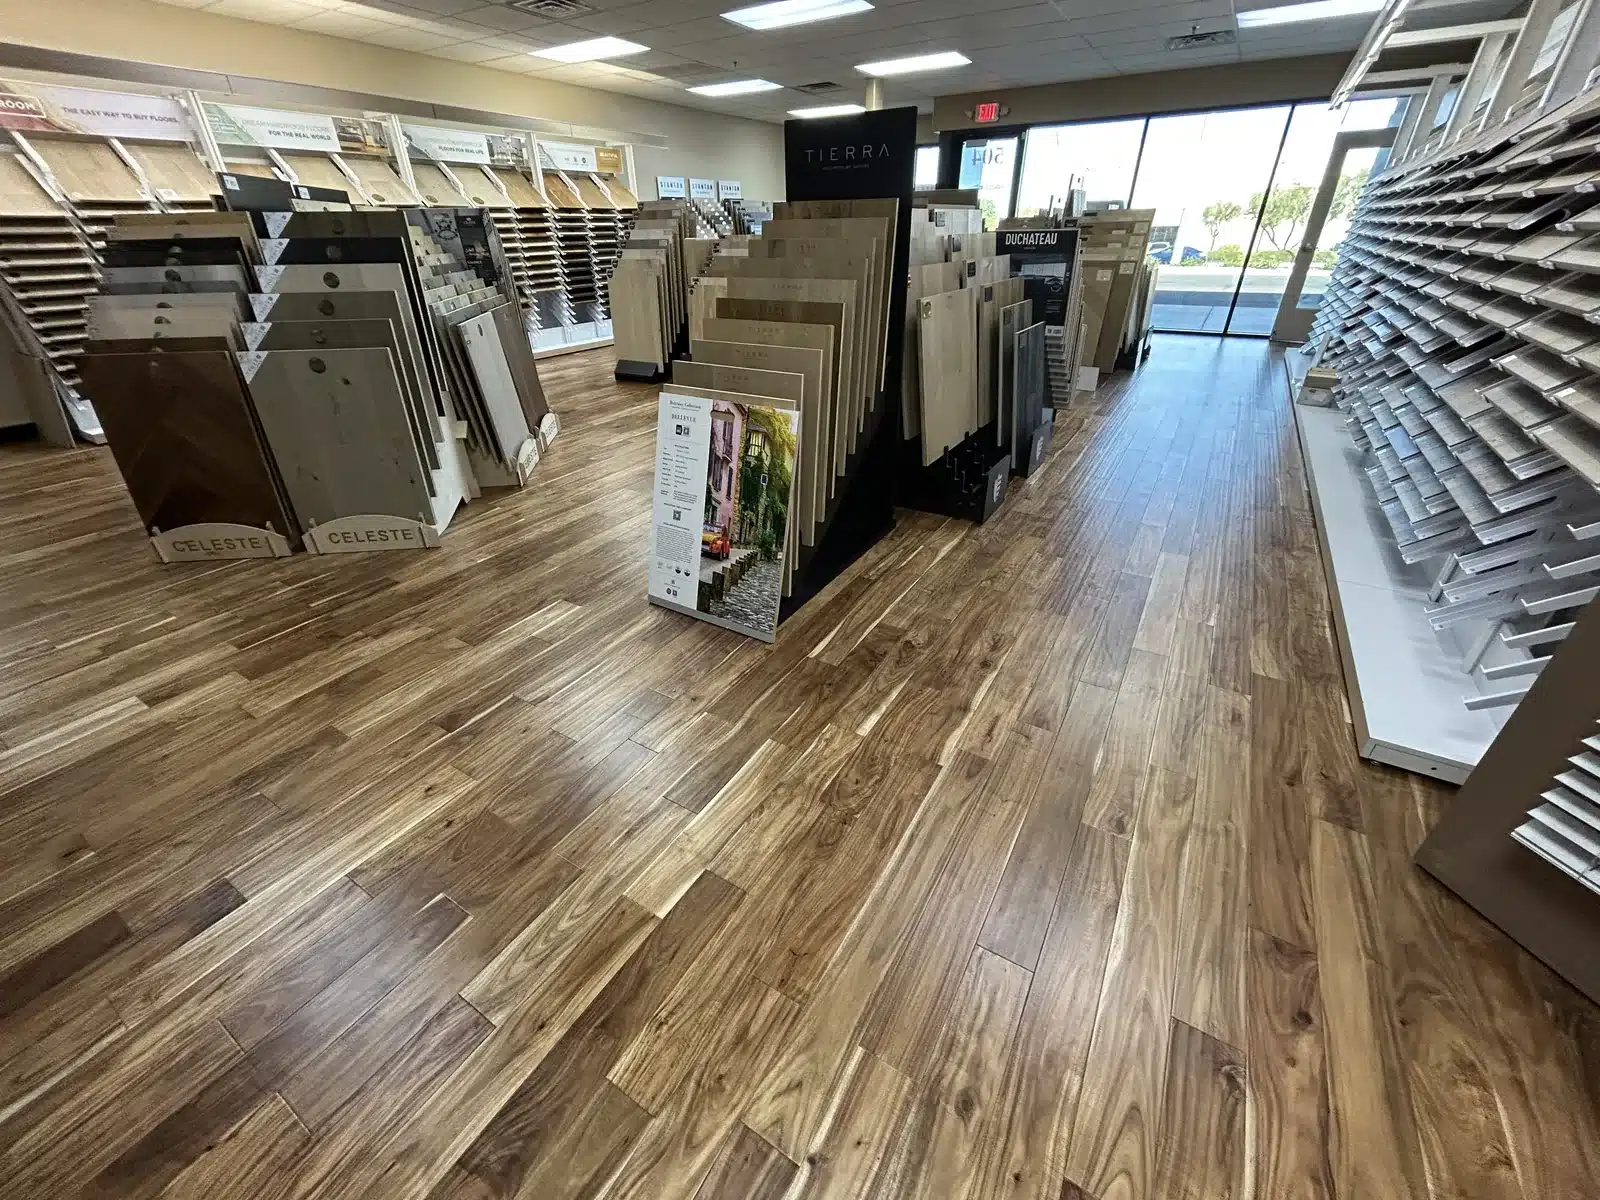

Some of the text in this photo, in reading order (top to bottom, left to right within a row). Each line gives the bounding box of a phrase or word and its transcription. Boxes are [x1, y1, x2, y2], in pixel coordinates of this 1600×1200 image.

[80, 108, 101, 116] EASY
[103, 110, 120, 118] WAY
[978, 103, 996, 120] EXIT
[804, 143, 890, 163] TIERRA
[692, 183, 713, 191] STANTON
[1005, 232, 1058, 245] DUCHATEAU
[328, 528, 414, 544] CELESTE
[172, 537, 262, 552] CELESTE
